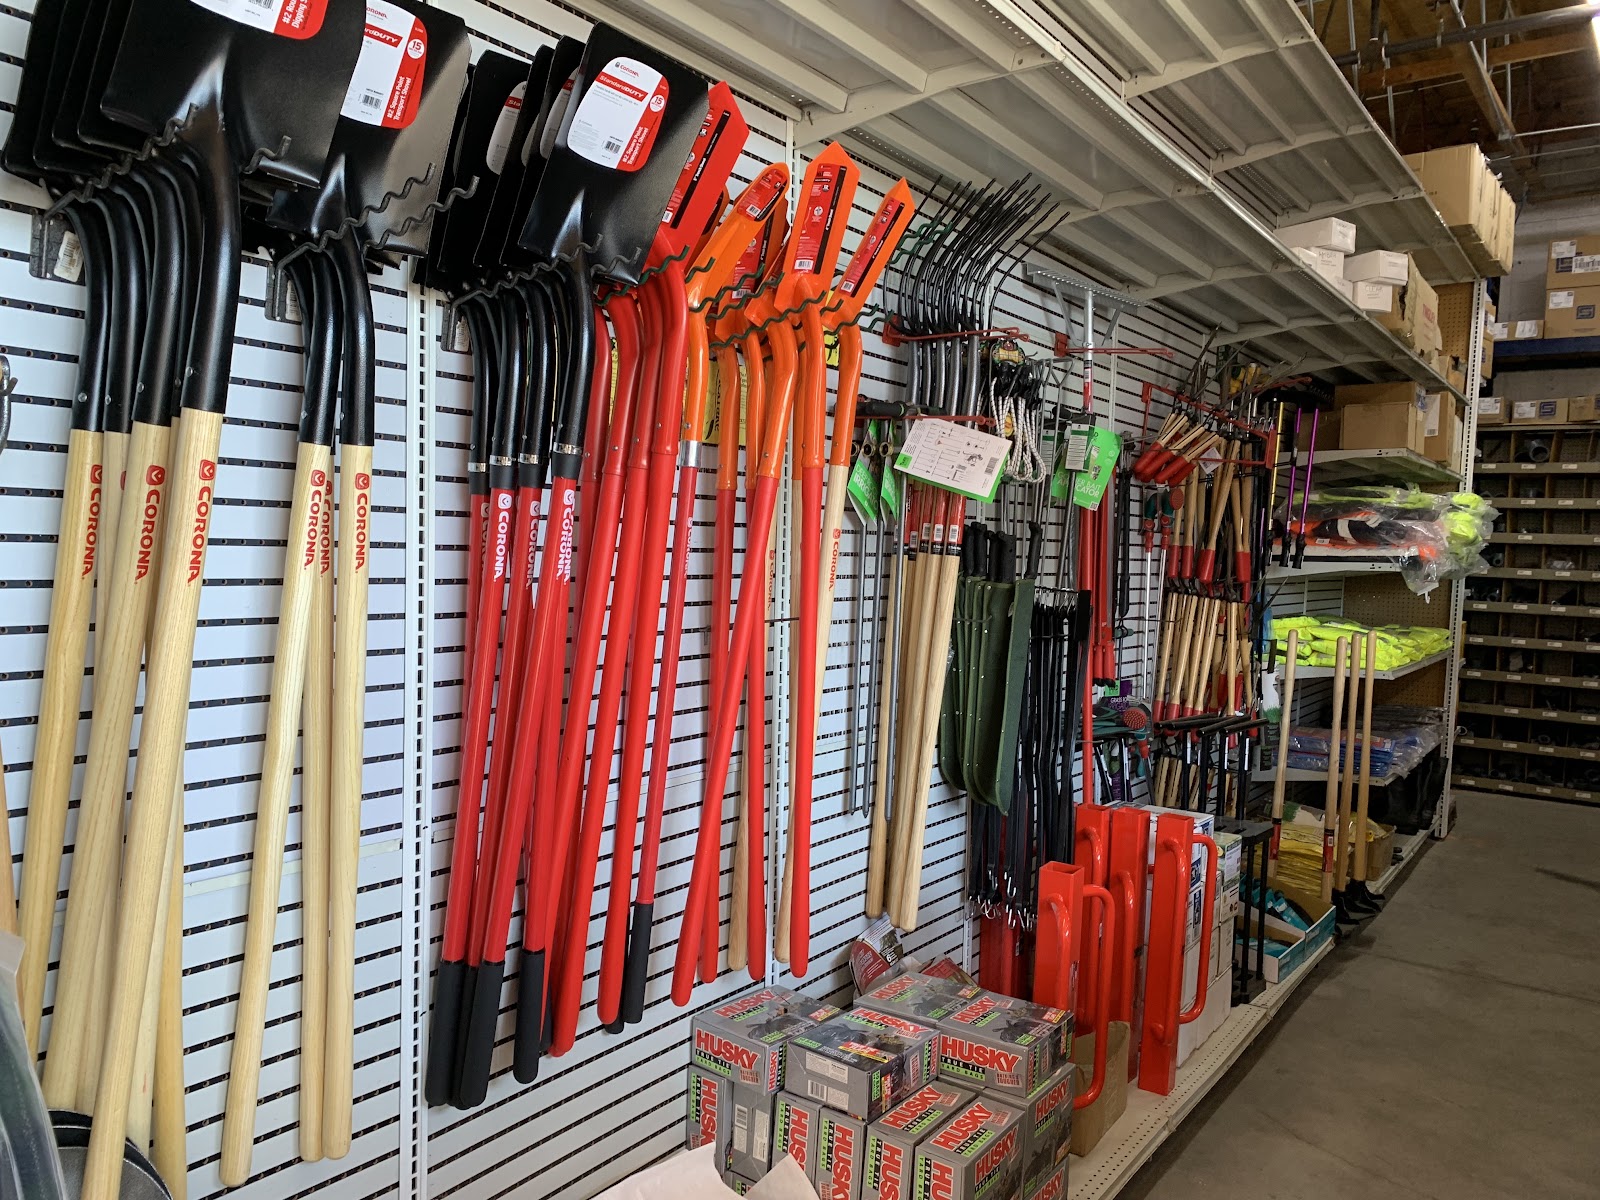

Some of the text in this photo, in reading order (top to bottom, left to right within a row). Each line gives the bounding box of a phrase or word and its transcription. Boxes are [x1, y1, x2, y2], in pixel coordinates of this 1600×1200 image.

[366, 6, 388, 19] ORONA
[365, 27, 399, 43] rdDUTY
[412, 40, 422, 51] 15
[390, 91, 401, 111] Square
[393, 95, 405, 121] Transport
[654, 96, 663, 105] 15
[82, 487, 102, 577] CORONA
[135, 489, 161, 581] CORONA
[187, 486, 212, 584] CORONA
[304, 489, 322, 567] CORONA
[355, 492, 368, 571] CORONA
[494, 511, 510, 579] CORONA
[556, 507, 572, 578] CORONA
[526, 518, 539, 587] CORONA
[829, 541, 839, 590] CORONA
[713, 988, 776, 1018] HUSKY
[868, 974, 919, 1000] HUSKY
[848, 1006, 934, 1034] HUSKY
[949, 995, 1000, 1024] HUSKY
[695, 1028, 761, 1070] HUSKY
[696, 1049, 731, 1069] TRUE TIE
[696, 1056, 731, 1076] YARD BAGS
[940, 1034, 1023, 1073] HUSKY
[941, 1056, 984, 1074] TRUE TIE
[768, 1051, 778, 1091] HUSKY
[941, 1062, 984, 1080] YARD BAGS
[700, 1077, 718, 1147] HUSK
[879, 1085, 943, 1129] HUSKY
[1034, 1075, 1071, 1124] HUSKY
[911, 1110, 942, 1133] YARD BAGS
[929, 1101, 993, 1151] HUSKY
[955, 1127, 988, 1154] TRUE TIE
[963, 1130, 994, 1156] YARD BAGS
[975, 1124, 1019, 1185] HUSKY
